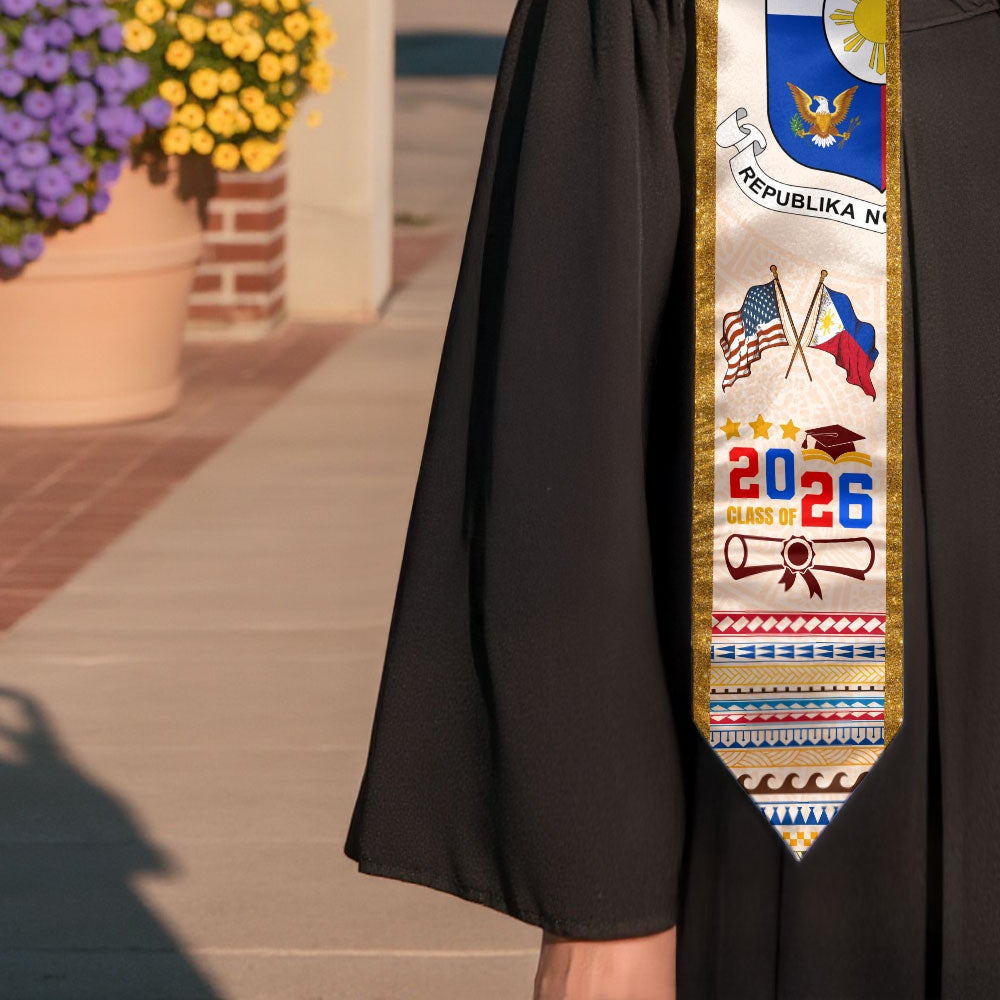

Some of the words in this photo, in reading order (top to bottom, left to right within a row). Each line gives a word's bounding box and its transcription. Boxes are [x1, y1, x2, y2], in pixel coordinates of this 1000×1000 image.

[738, 165, 855, 220] REPUBLIKA
[865, 208, 886, 226] N
[726, 505, 774, 525] CLASS
[778, 508, 797, 526] OF
